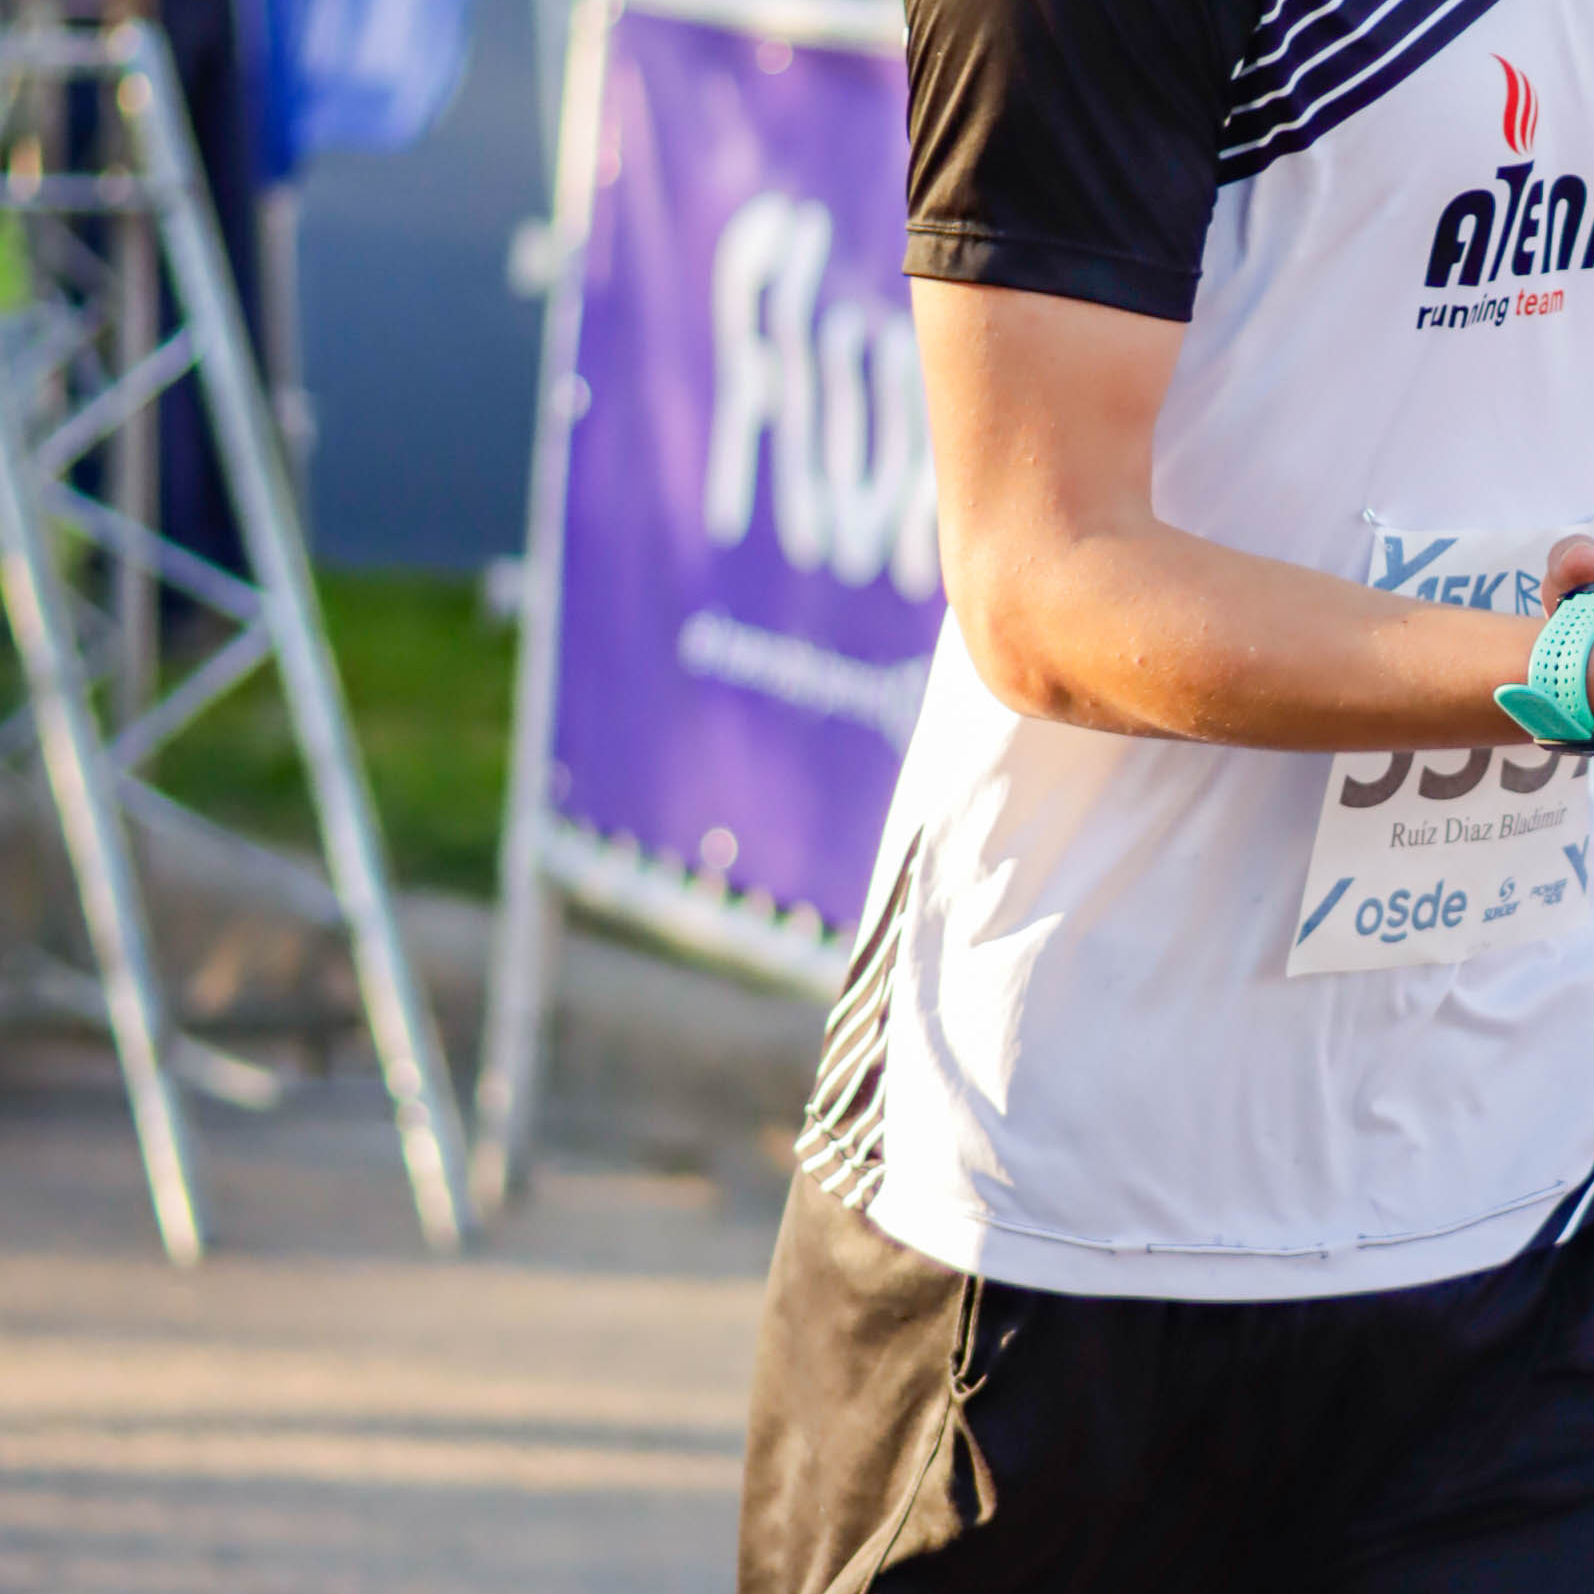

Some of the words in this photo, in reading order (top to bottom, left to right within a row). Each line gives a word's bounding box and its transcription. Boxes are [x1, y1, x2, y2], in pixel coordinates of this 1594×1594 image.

[1416, 293, 1510, 330] running
[1515, 289, 1564, 316] team
[1444, 817, 1493, 844] Diaz
[1355, 878, 1467, 943] osde
